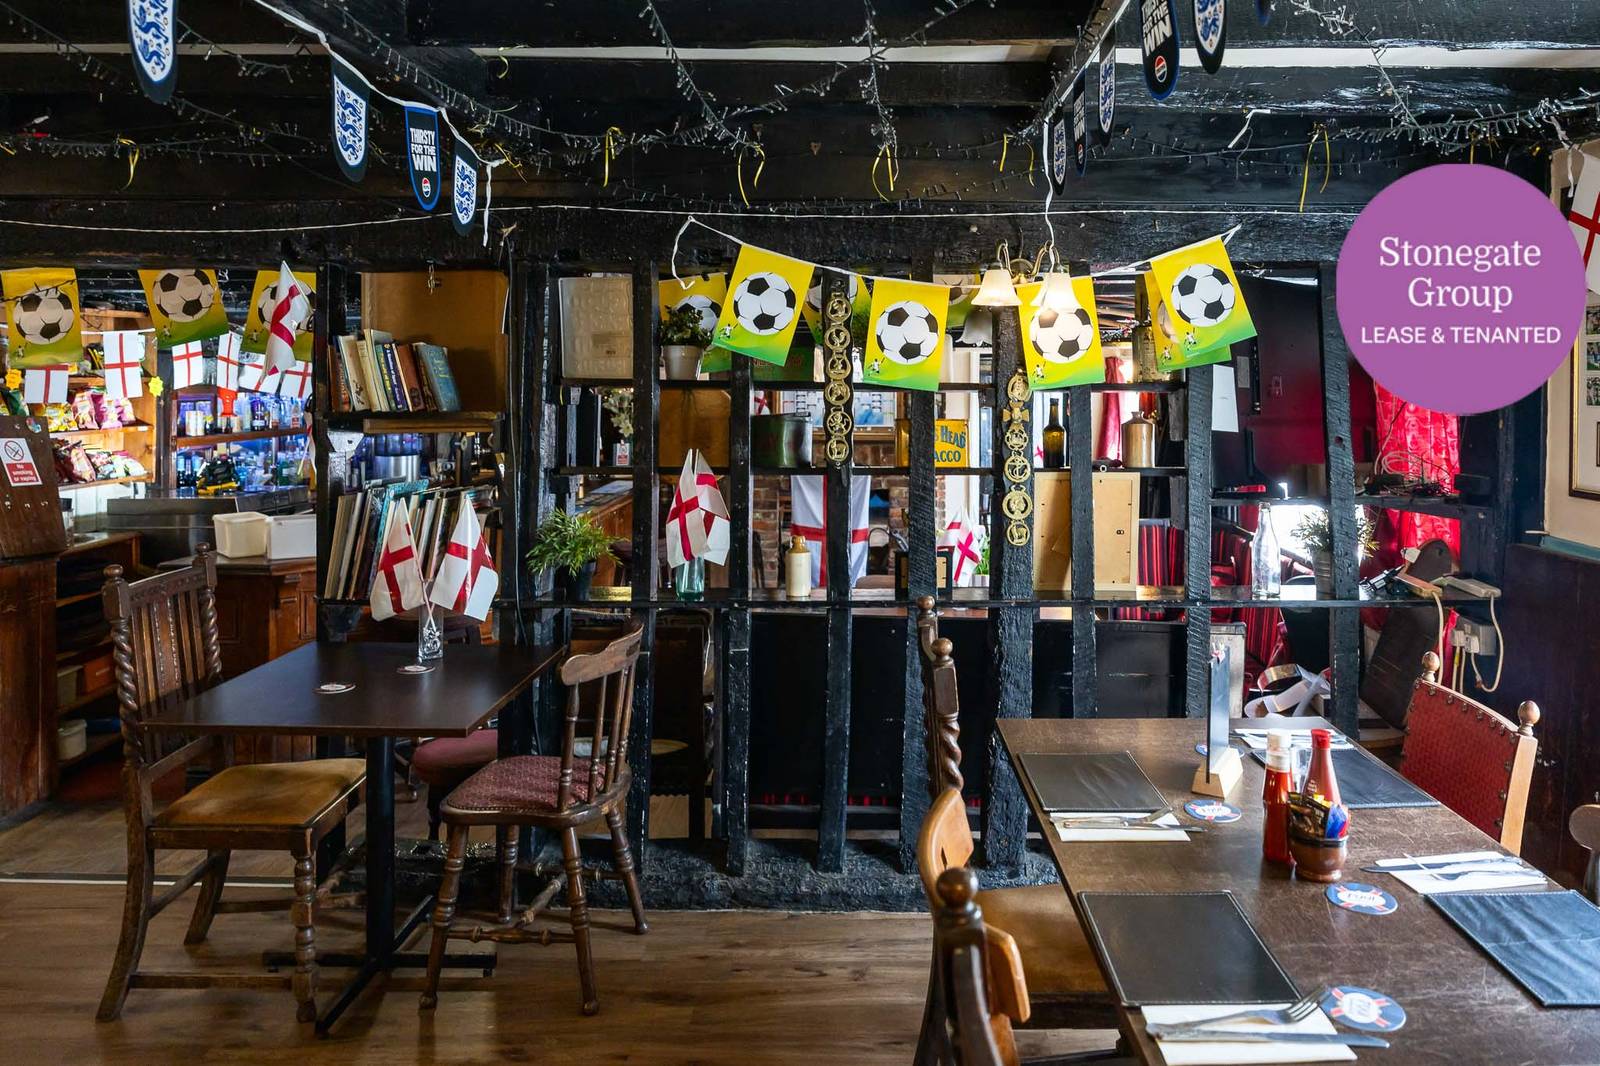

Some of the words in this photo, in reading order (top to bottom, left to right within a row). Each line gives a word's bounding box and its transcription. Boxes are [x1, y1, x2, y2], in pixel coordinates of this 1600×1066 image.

[1152, 1, 1169, 24] THE
[1144, 14, 1173, 57] WIN
[410, 127, 435, 146] THIRSTY
[411, 143, 424, 154] FOR
[424, 145, 436, 155] THE
[412, 154, 437, 172] WIN
[940, 425, 966, 448] HEAD
[934, 450, 961, 463] ACCO
